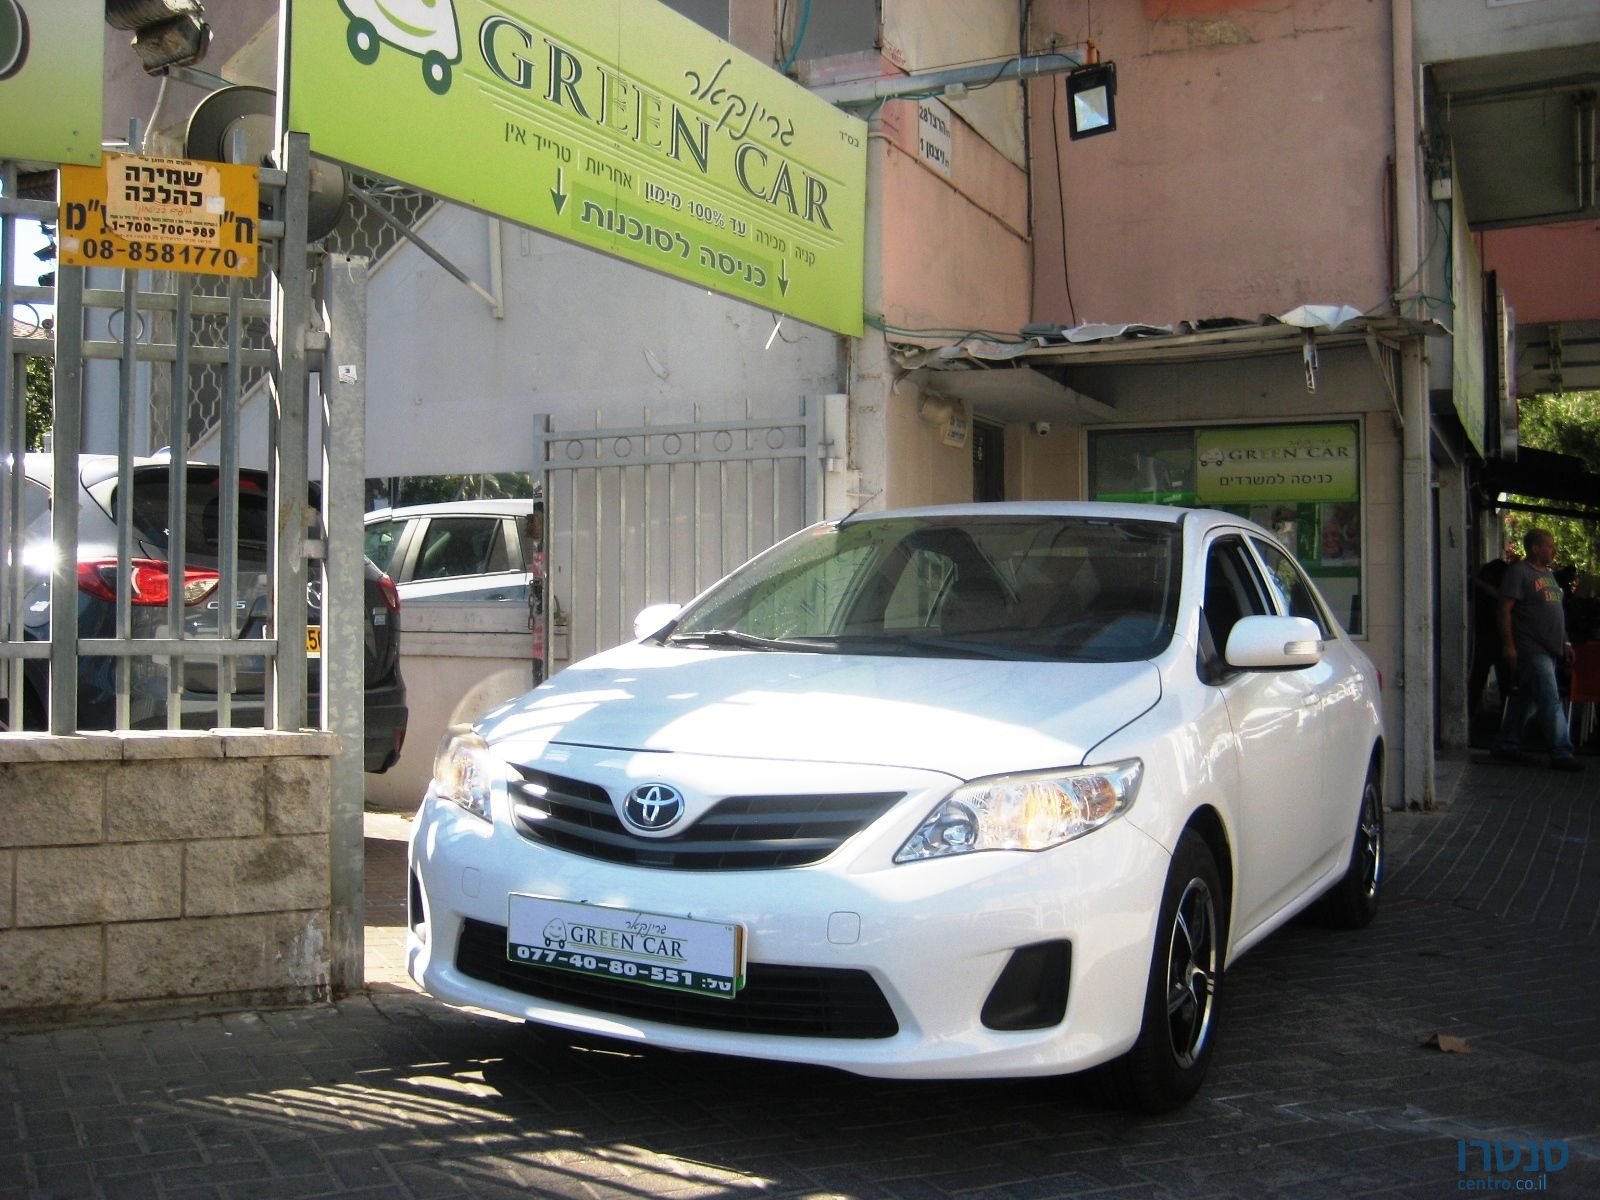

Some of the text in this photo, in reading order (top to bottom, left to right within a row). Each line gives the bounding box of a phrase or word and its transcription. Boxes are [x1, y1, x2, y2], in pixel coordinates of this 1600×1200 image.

[684, 58, 795, 147] גרינקאר
[478, 15, 833, 231] GREEN CAR
[125, 165, 203, 187] שמירה
[125, 185, 203, 207] כהלכה
[505, 122, 816, 267] קניה מכירה עד 100% מימון אחריות טרייד אין
[112, 221, 216, 238] 1-700-700-989
[581, 200, 767, 288] כניסה לסוכנות
[83, 238, 238, 269] 08-8581770
[1228, 446, 1350, 461] GREEN CAR
[1219, 473, 1334, 486] כניסה למשרדים
[570, 926, 684, 958] GREEN CAR
[516, 945, 732, 992] טל: 077-40-80-551
